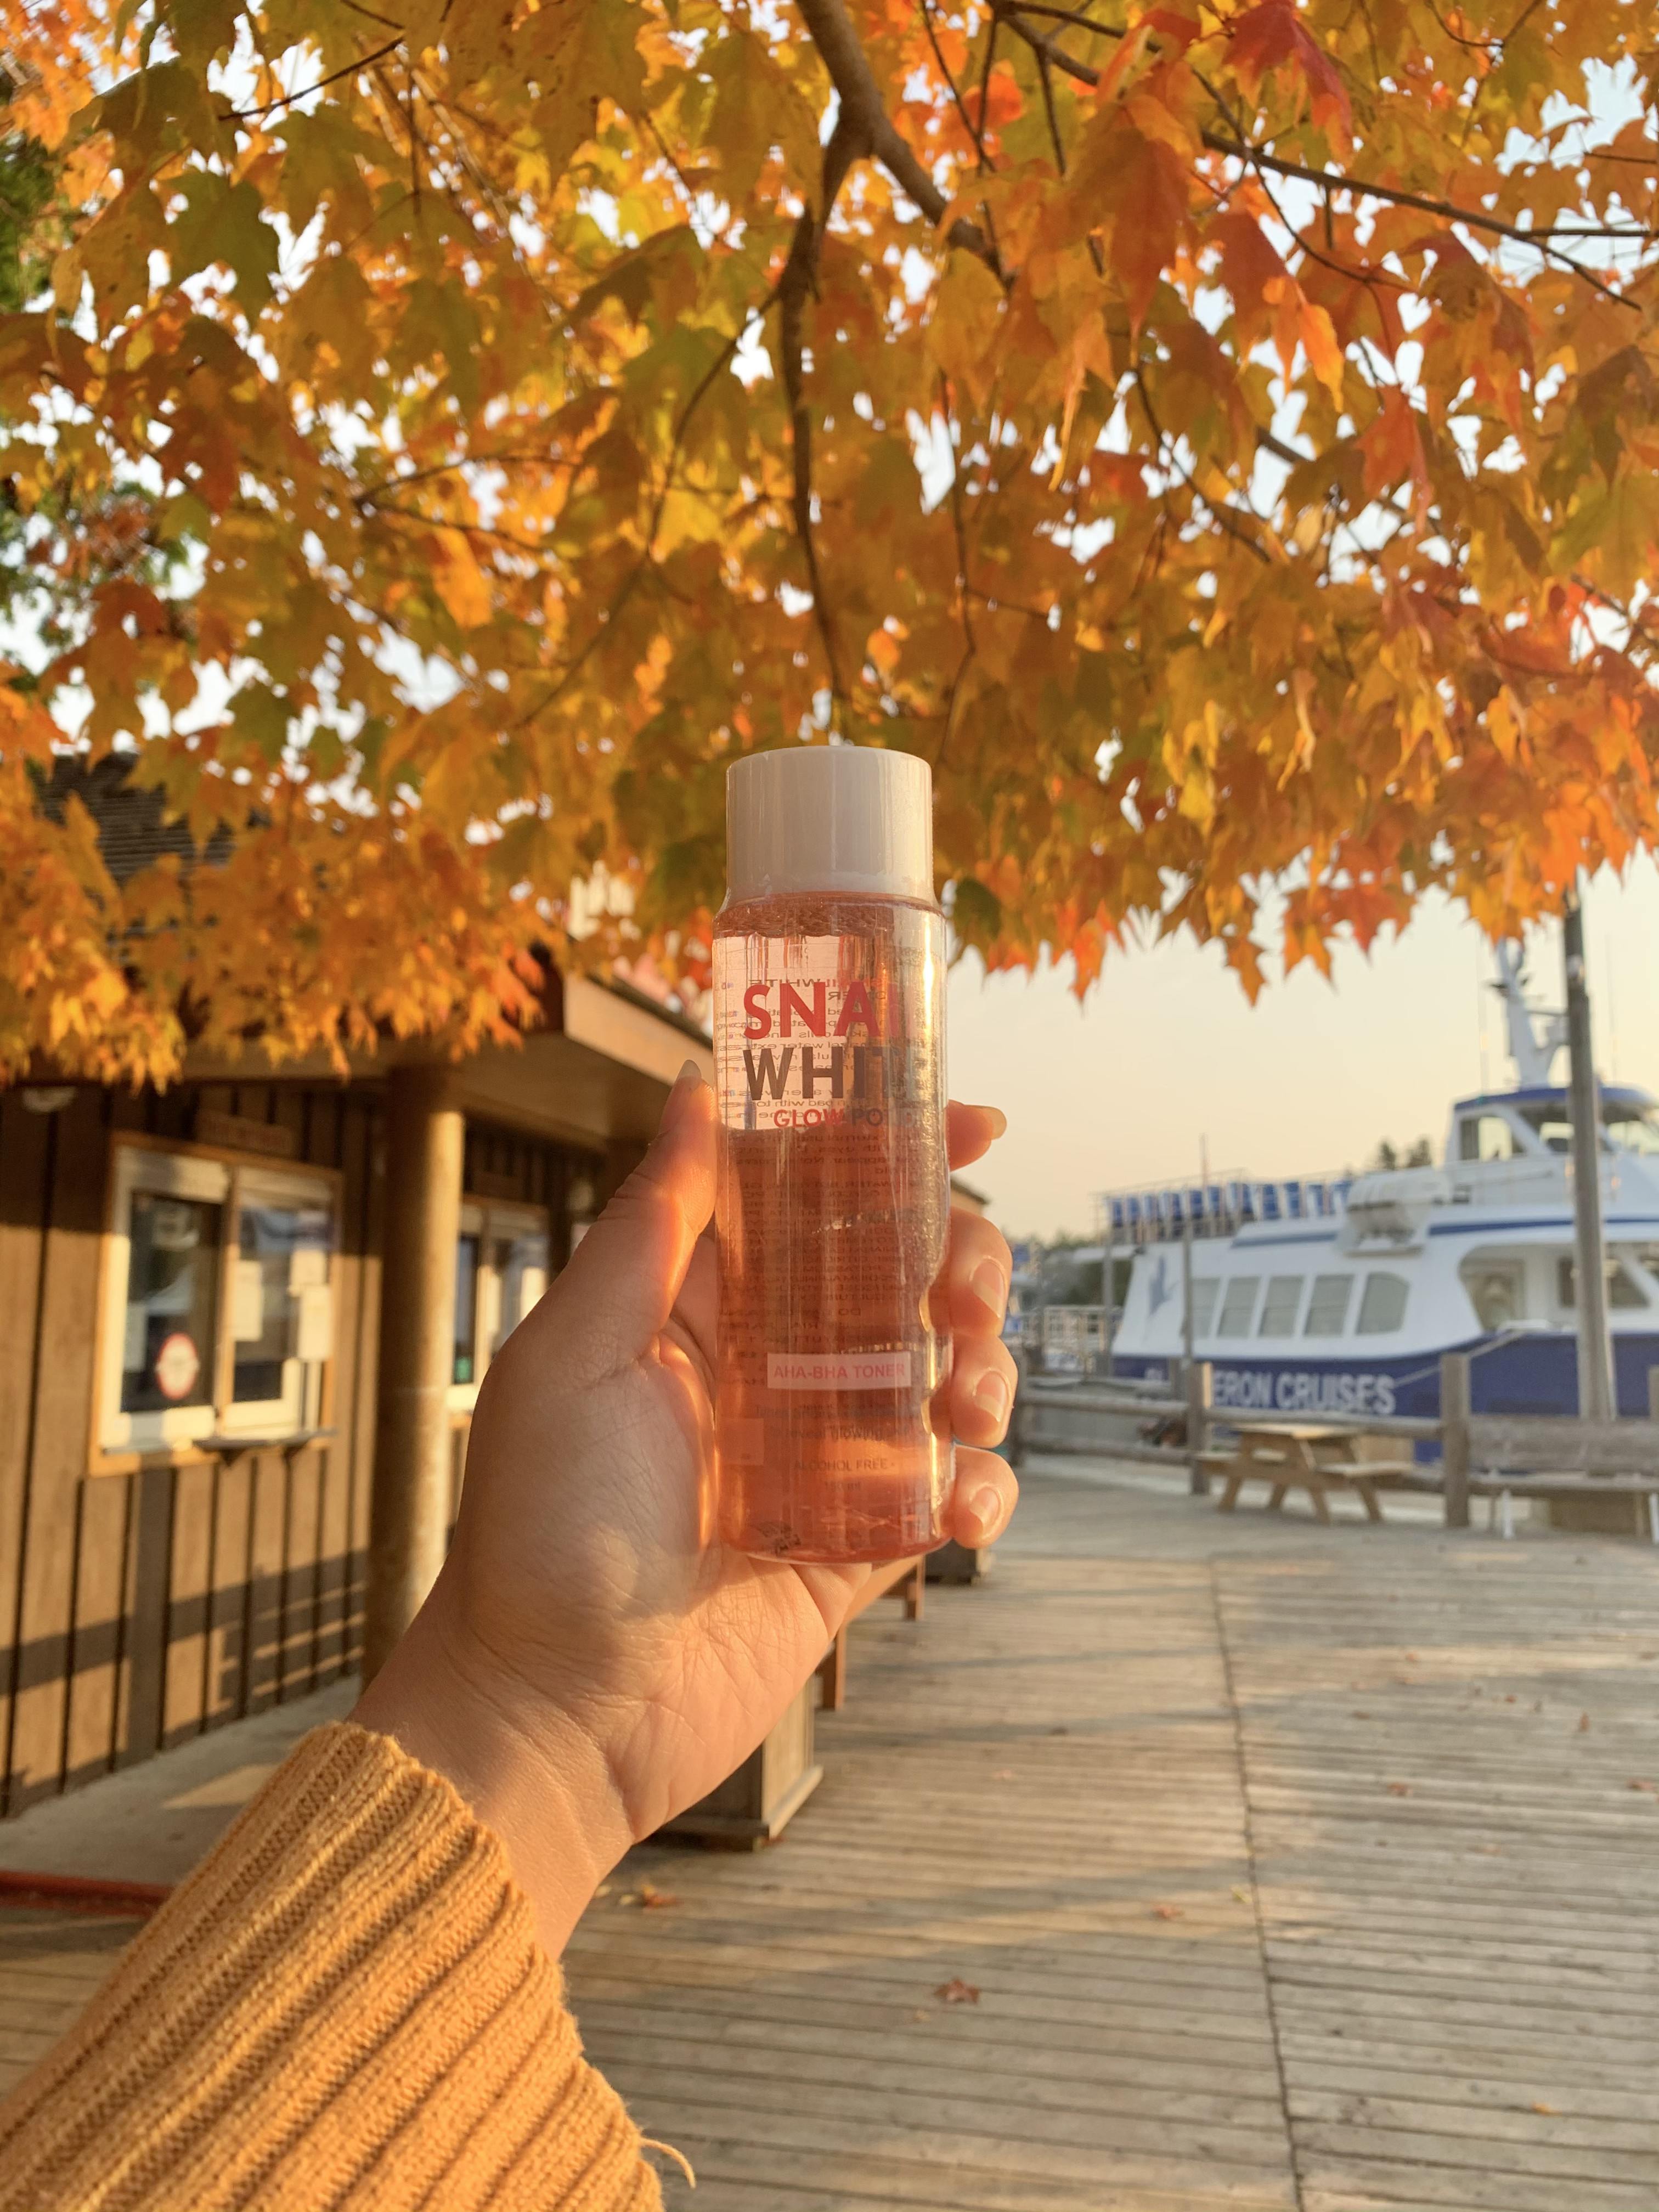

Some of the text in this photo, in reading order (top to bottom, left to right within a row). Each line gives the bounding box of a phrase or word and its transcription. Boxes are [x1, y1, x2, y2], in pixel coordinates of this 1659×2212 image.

[774, 1109, 844, 1128] GLOW
[774, 1365, 848, 1379] AHA-BHA
[854, 1362, 905, 1379] TONER
[1276, 1372, 1397, 1414] CRUISES
[794, 1458, 887, 1471] ALCOHOL FREE
